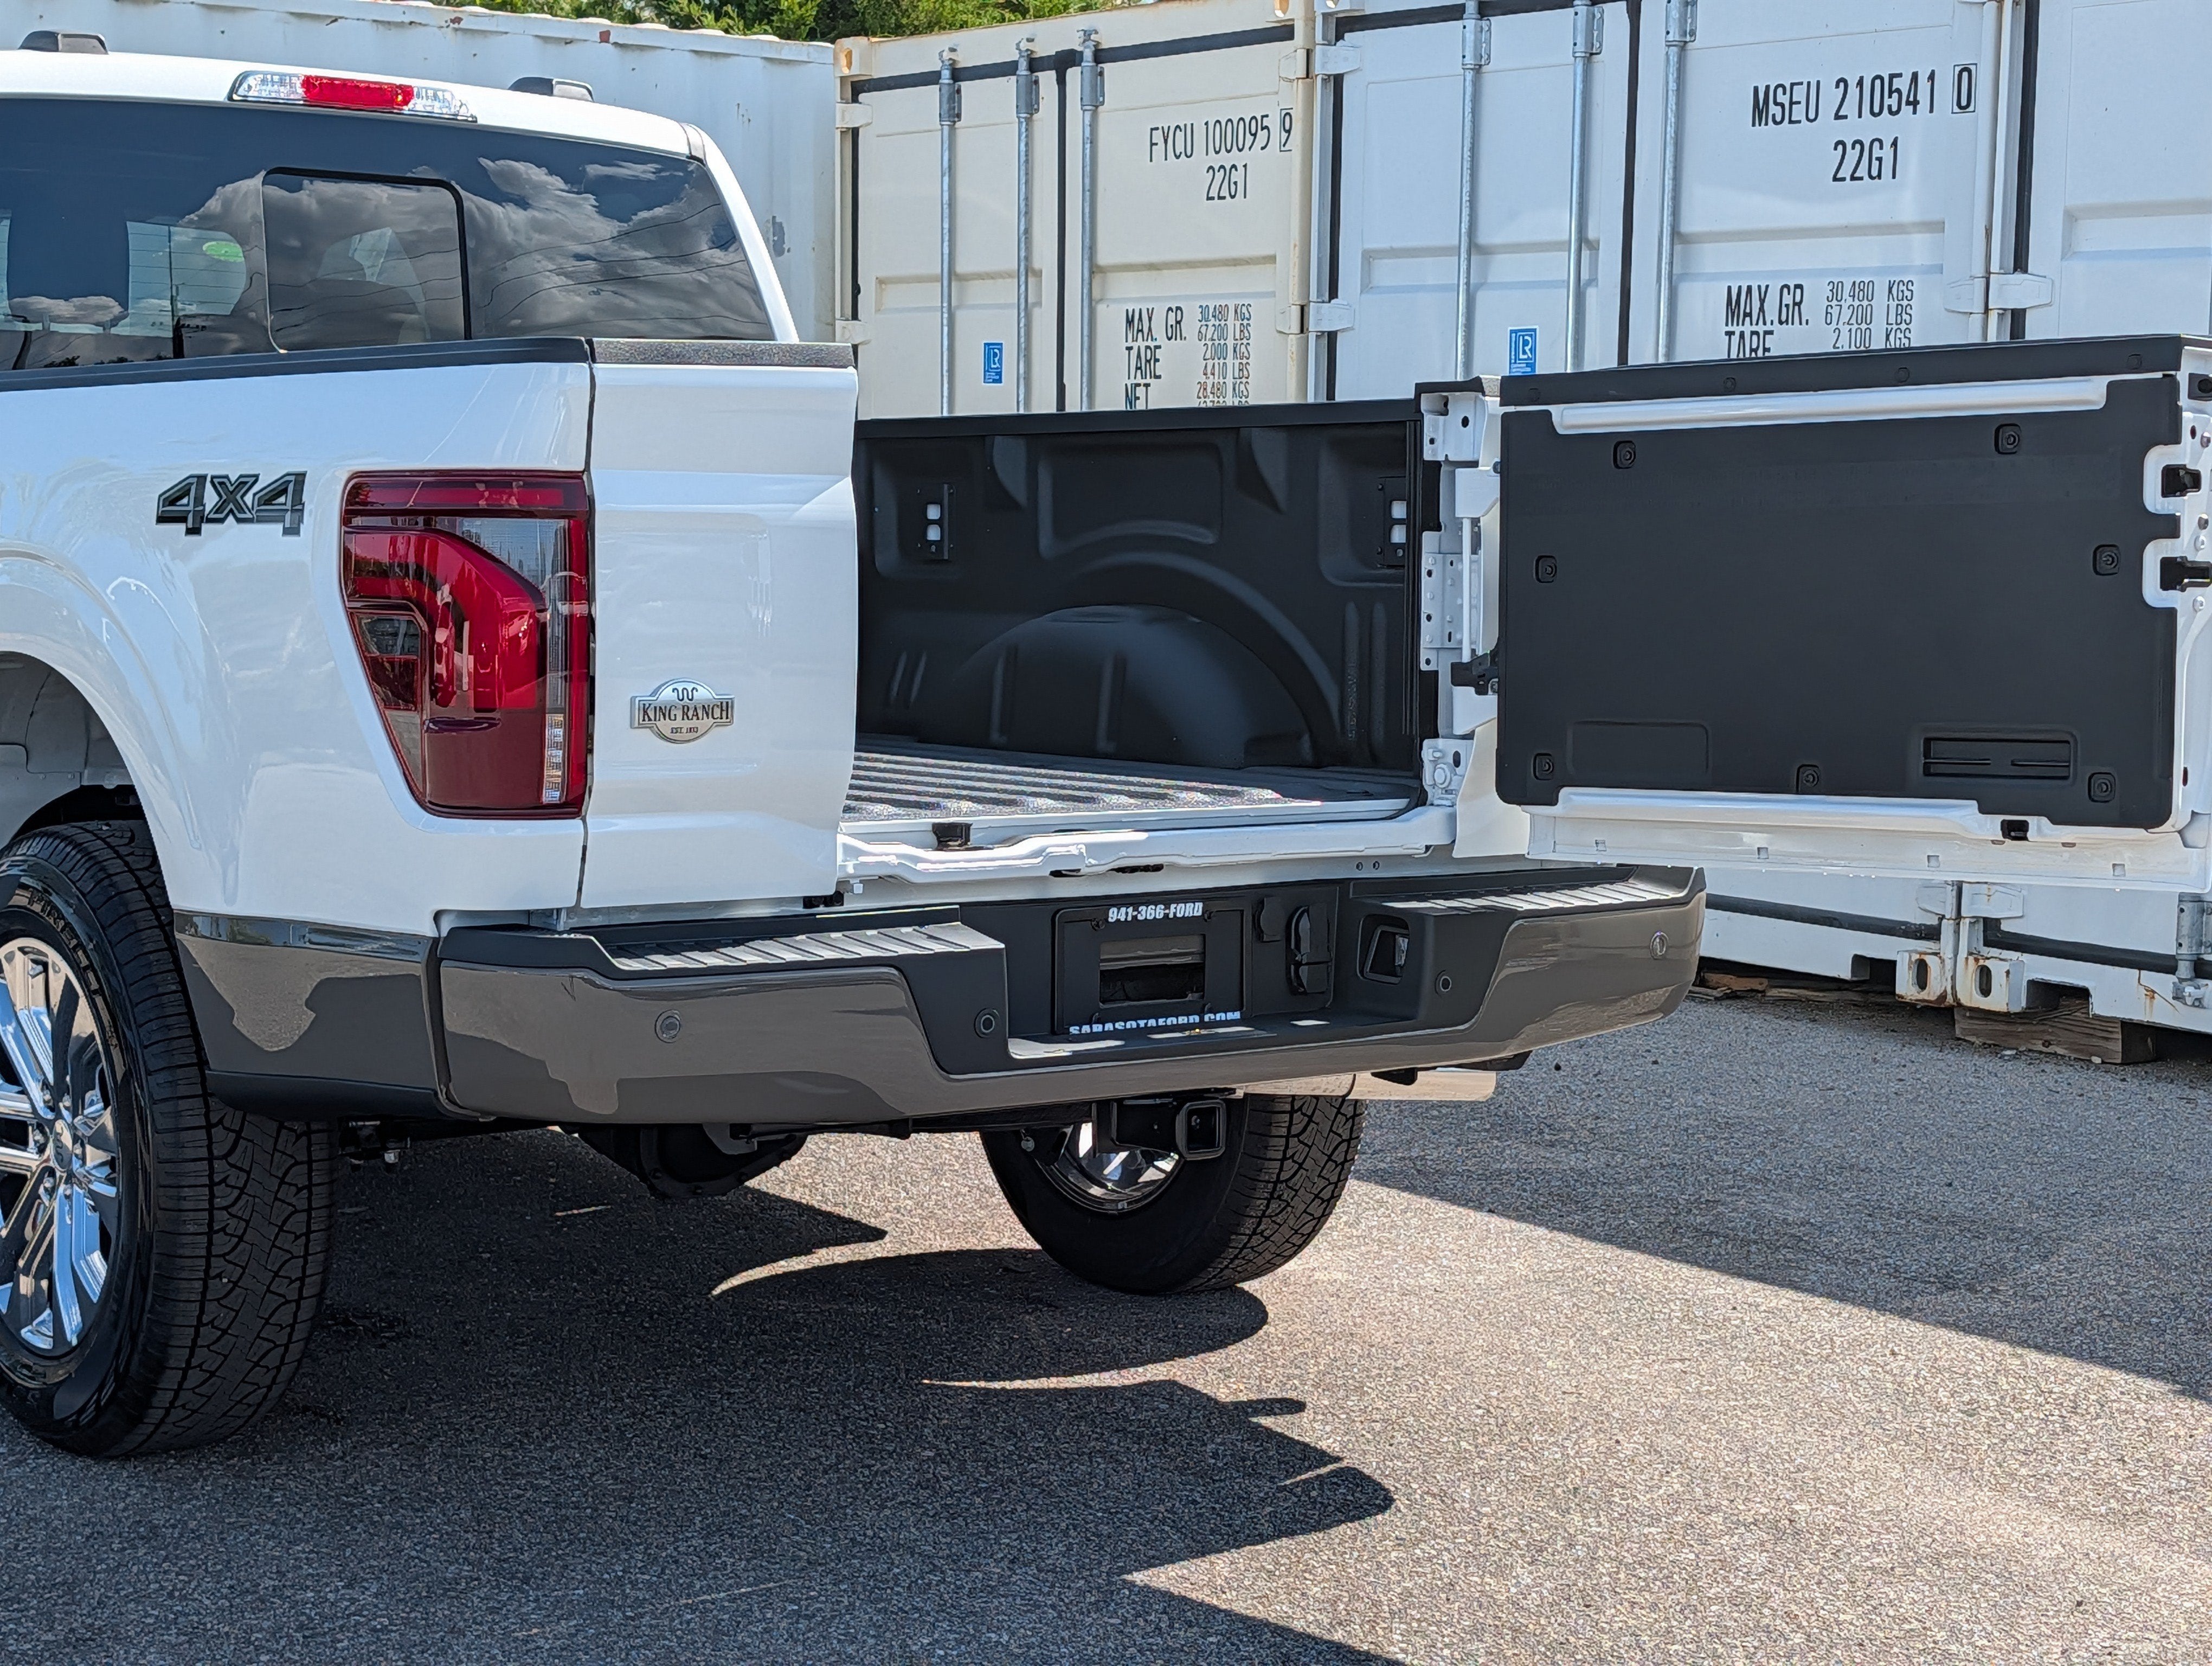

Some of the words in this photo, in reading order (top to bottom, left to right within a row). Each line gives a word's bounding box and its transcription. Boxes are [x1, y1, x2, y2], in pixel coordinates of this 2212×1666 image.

[1752, 80, 1820, 127] MSEU
[1834, 69, 1935, 120] 210541
[1956, 66, 1972, 110] 0
[1149, 123, 1194, 162] FYCU
[1204, 114, 1270, 156] 100095
[1282, 112, 1293, 148] 9
[1832, 136, 1898, 182] 22G1
[1206, 163, 1247, 201] 22G1
[1827, 280, 1874, 302] 30.480
[1888, 279, 1914, 302] KGS
[1125, 307, 1158, 343] MAX.
[1166, 306, 1187, 341] GR.
[1233, 304, 1252, 321] KGS
[1825, 304, 1873, 325] 67.200
[1886, 303, 1912, 325] LBS
[1233, 323, 1251, 341] LBS
[1725, 330, 1774, 358] TARE
[1832, 327, 1872, 350] 2.100
[1885, 327, 1912, 348] KGS
[1125, 345, 1162, 380] TARE
[1232, 342, 1251, 360] KGS
[1232, 362, 1250, 380] LBS
[1125, 382, 1151, 410] NET
[1232, 381, 1250, 399] KGS
[641, 703, 677, 722] KING
[681, 701, 730, 721] RANCH
[1108, 902, 1204, 922] 941-366-FORD
